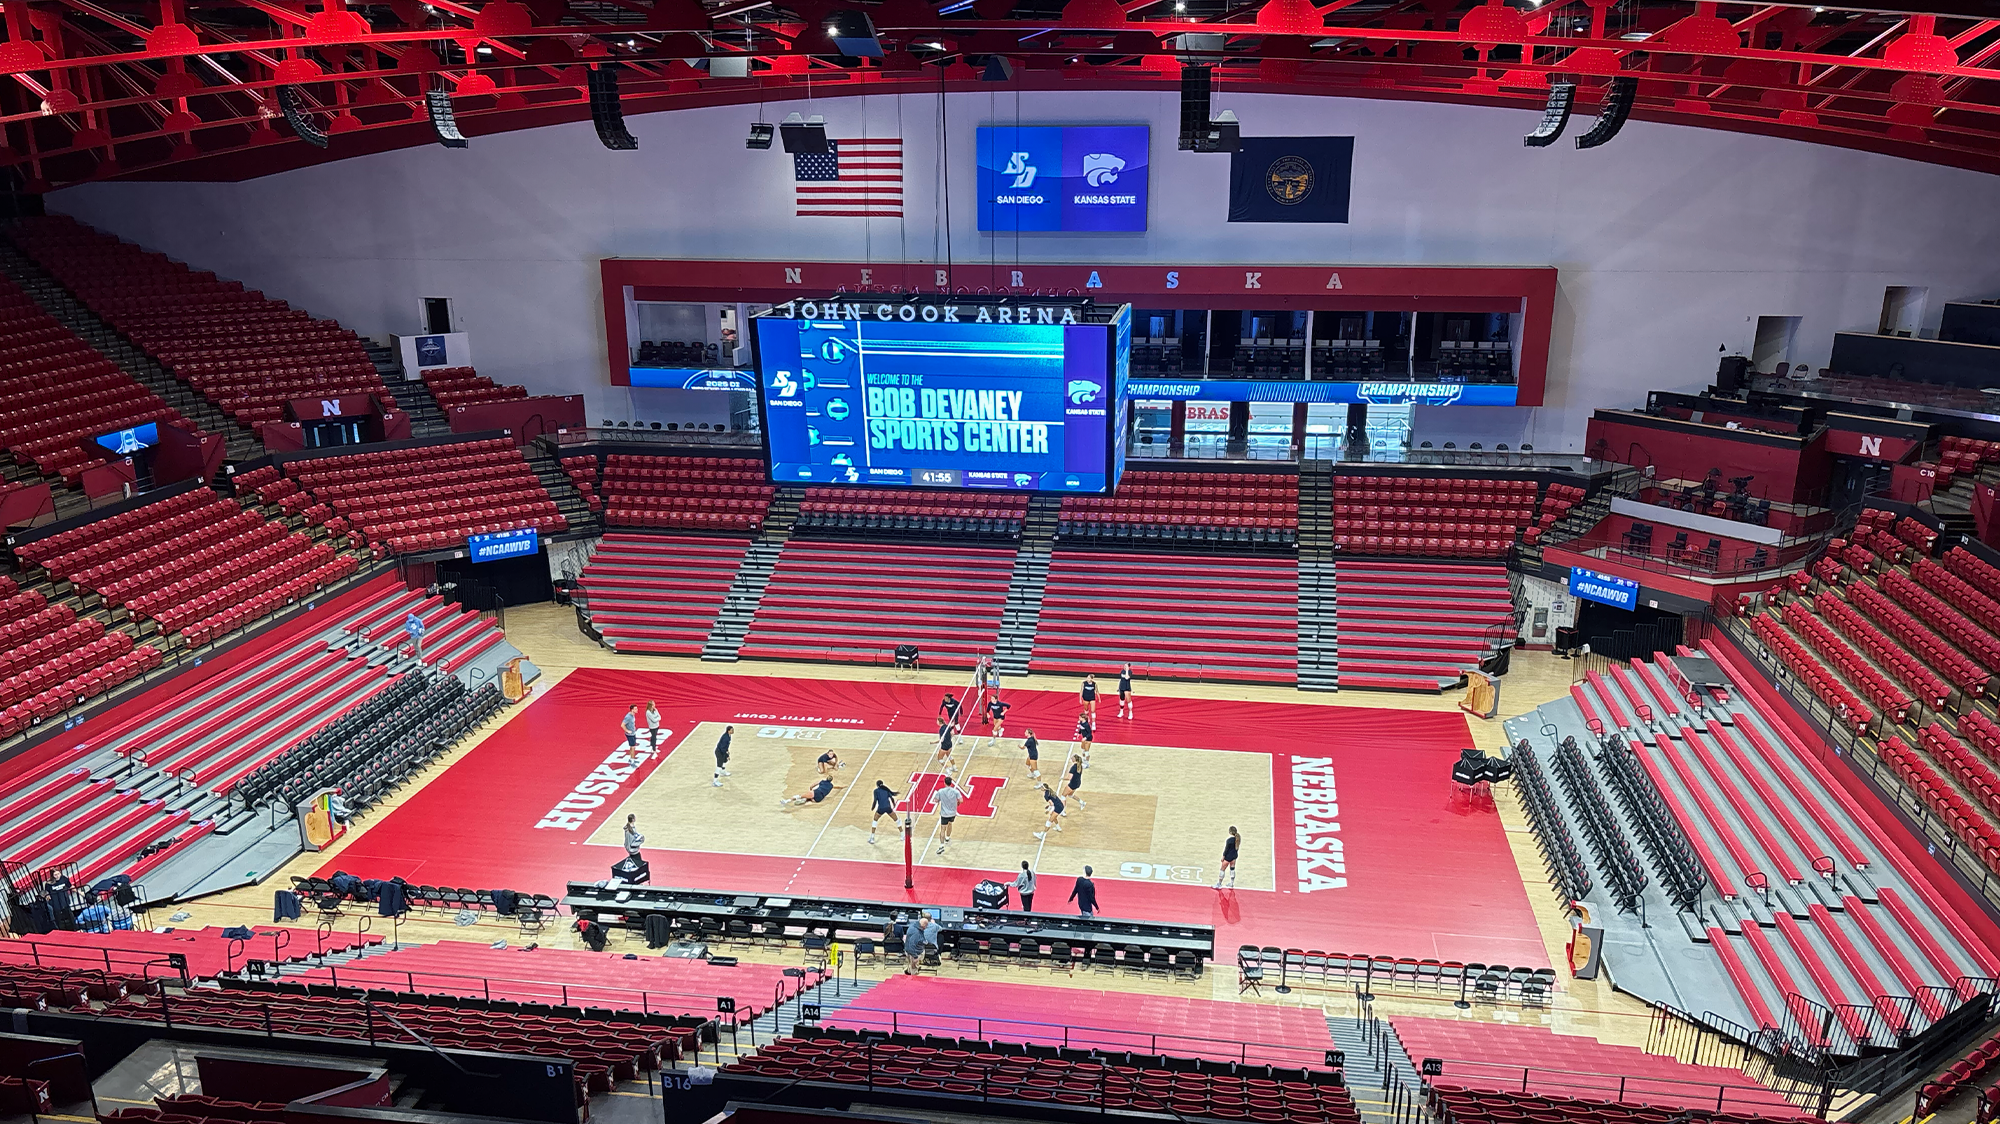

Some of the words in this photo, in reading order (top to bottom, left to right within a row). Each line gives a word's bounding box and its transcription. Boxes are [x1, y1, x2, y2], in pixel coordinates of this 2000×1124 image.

[997, 195, 1015, 204] SAN
[1017, 195, 1044, 204] DIEGO
[1074, 195, 1110, 204] KANSAS
[1110, 195, 1136, 204] STATE
[785, 301, 862, 320] JOHN
[877, 303, 959, 322] COOK
[975, 306, 1077, 325] ARENA
[868, 373, 900, 386] WELCOME
[901, 374, 910, 386] TO
[911, 374, 924, 386] THE
[1361, 383, 1460, 397] CHAMPIONSHIP
[321, 400, 342, 416] N
[868, 386, 916, 418] BOB
[920, 388, 1022, 420] DEVANEY
[870, 420, 959, 452] SPORTS
[964, 422, 1049, 454] CENTER
[1859, 436, 1882, 456] N
[922, 472, 952, 482] 41:55
[1920, 469, 1935, 478] C10
[478, 540, 531, 557] #NCAAWVB
[1576, 582, 1629, 604] #NCAAWVB
[534, 728, 674, 831] HUSKERS
[895, 772, 1010, 818] N
[1290, 755, 1348, 894] NEBRASKA
[250, 963, 262, 972] A1
[720, 1001, 731, 1009] A1
[804, 1008, 819, 1016] A14
[1326, 1055, 1343, 1064] A14
[546, 1066, 564, 1078] B1
[1424, 1063, 1442, 1072] A13
[664, 1076, 692, 1090] B16
[38, 1087, 50, 1104] N
